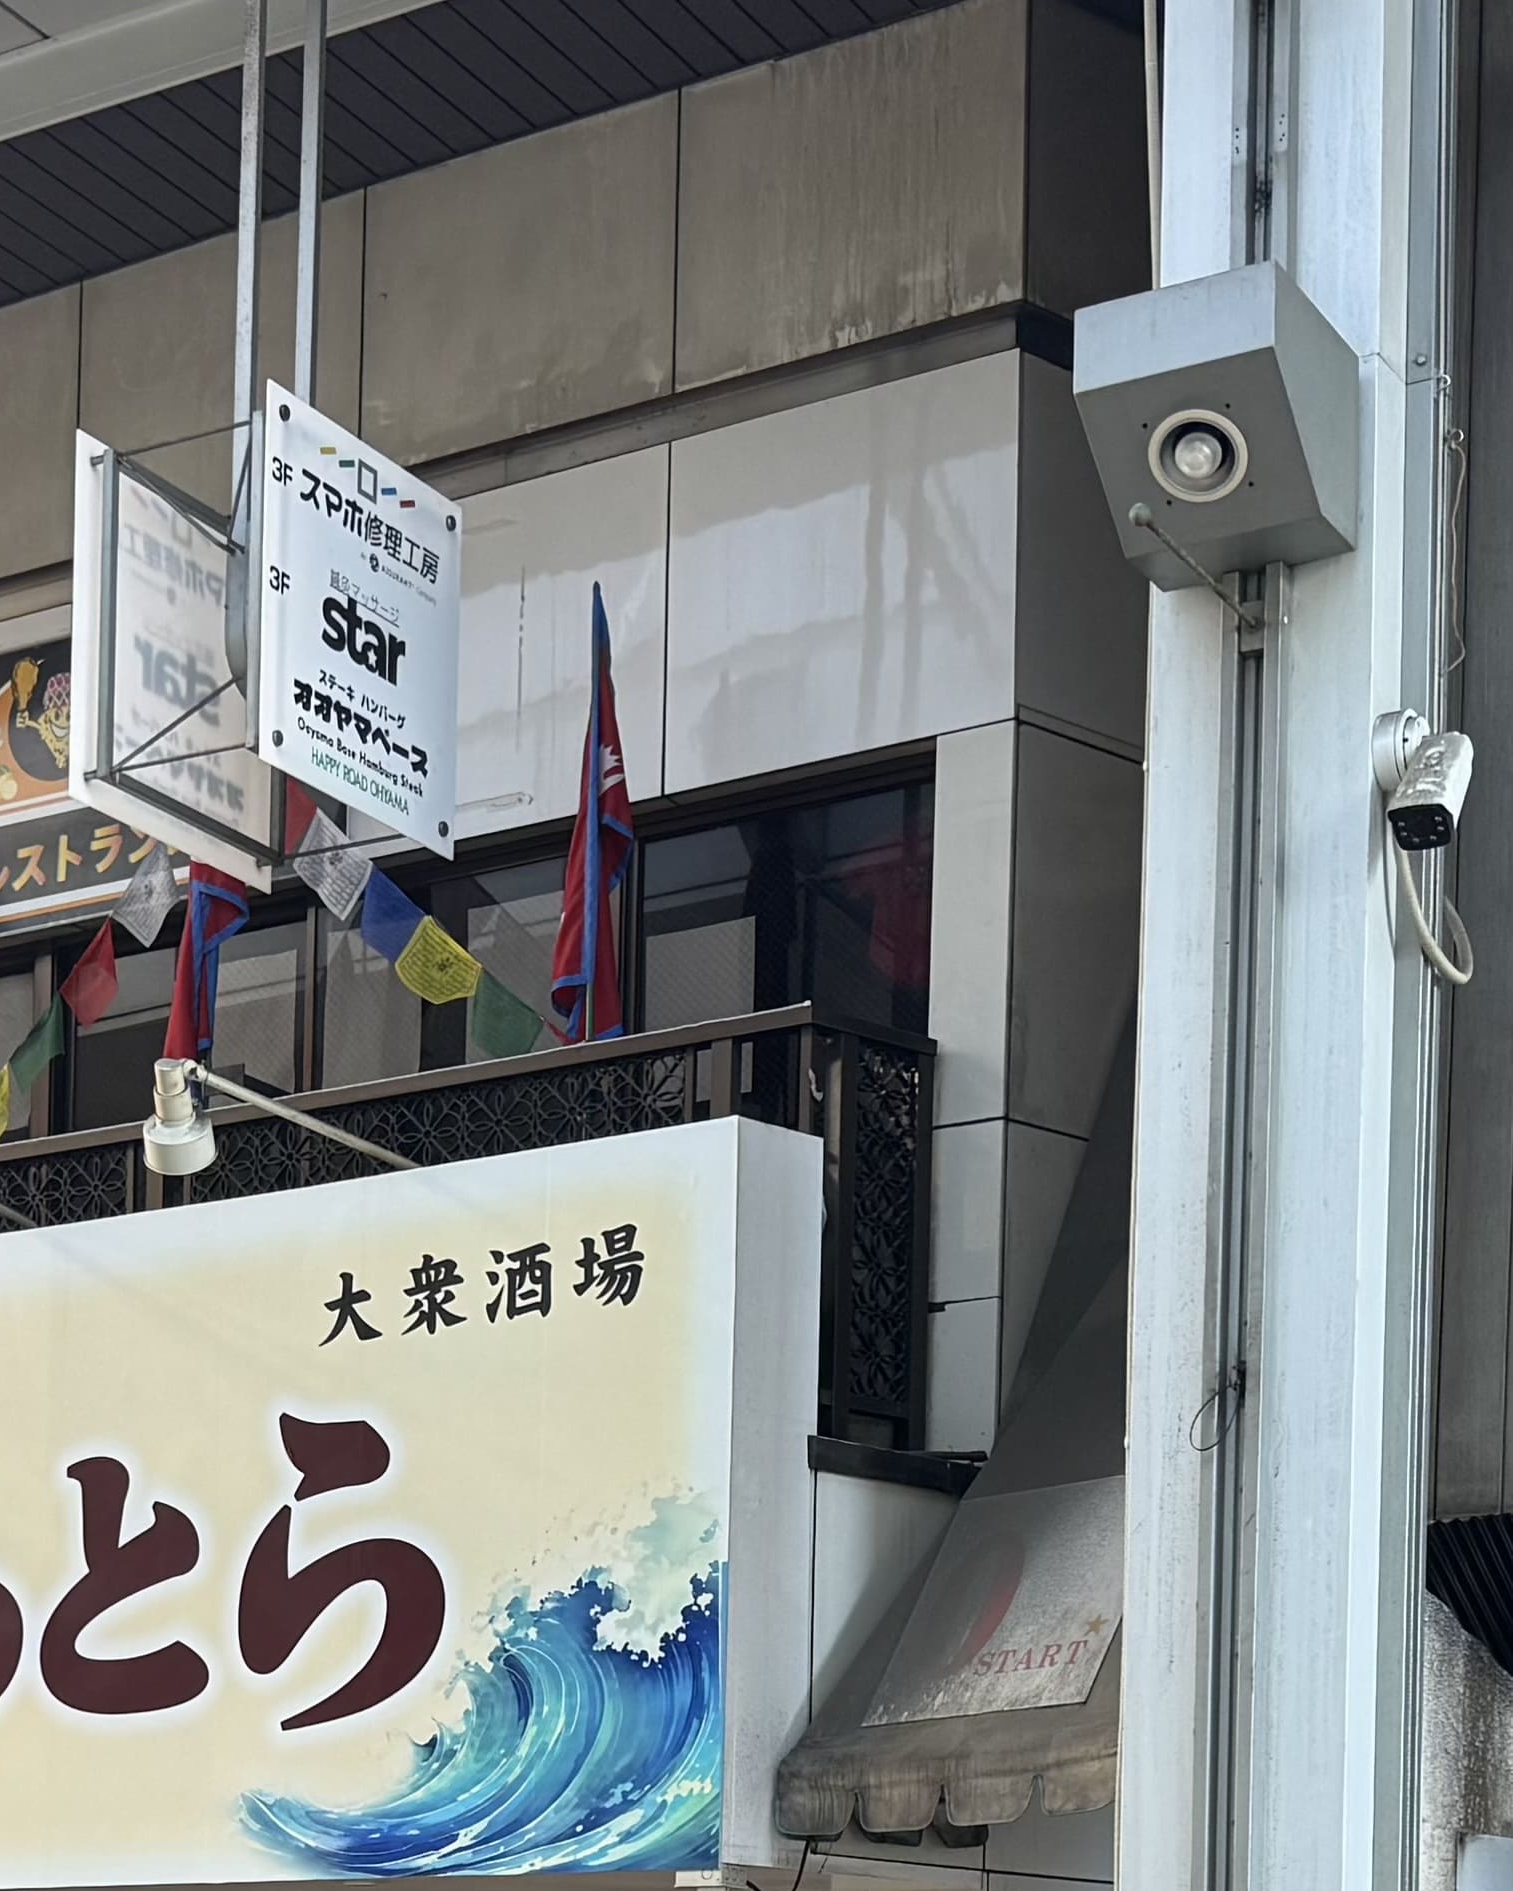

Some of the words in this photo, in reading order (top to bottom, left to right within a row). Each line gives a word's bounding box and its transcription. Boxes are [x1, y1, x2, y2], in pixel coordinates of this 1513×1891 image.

[272, 456, 293, 486] 3F
[300, 468, 440, 585] スマホ修理工房
[269, 565, 291, 595] 3F
[322, 596, 406, 687] star
[294, 678, 429, 778] オオヤマベース
[319, 669, 355, 701] ステーキ
[360, 694, 406, 729] ハンバーグ
[311, 747, 340, 777] HAPPY
[343, 765, 368, 792] ROAD
[370, 780, 409, 815] OHYAMA
[318, 1223, 645, 1348] 大衆酒場
[973, 1640, 1089, 1677] START
